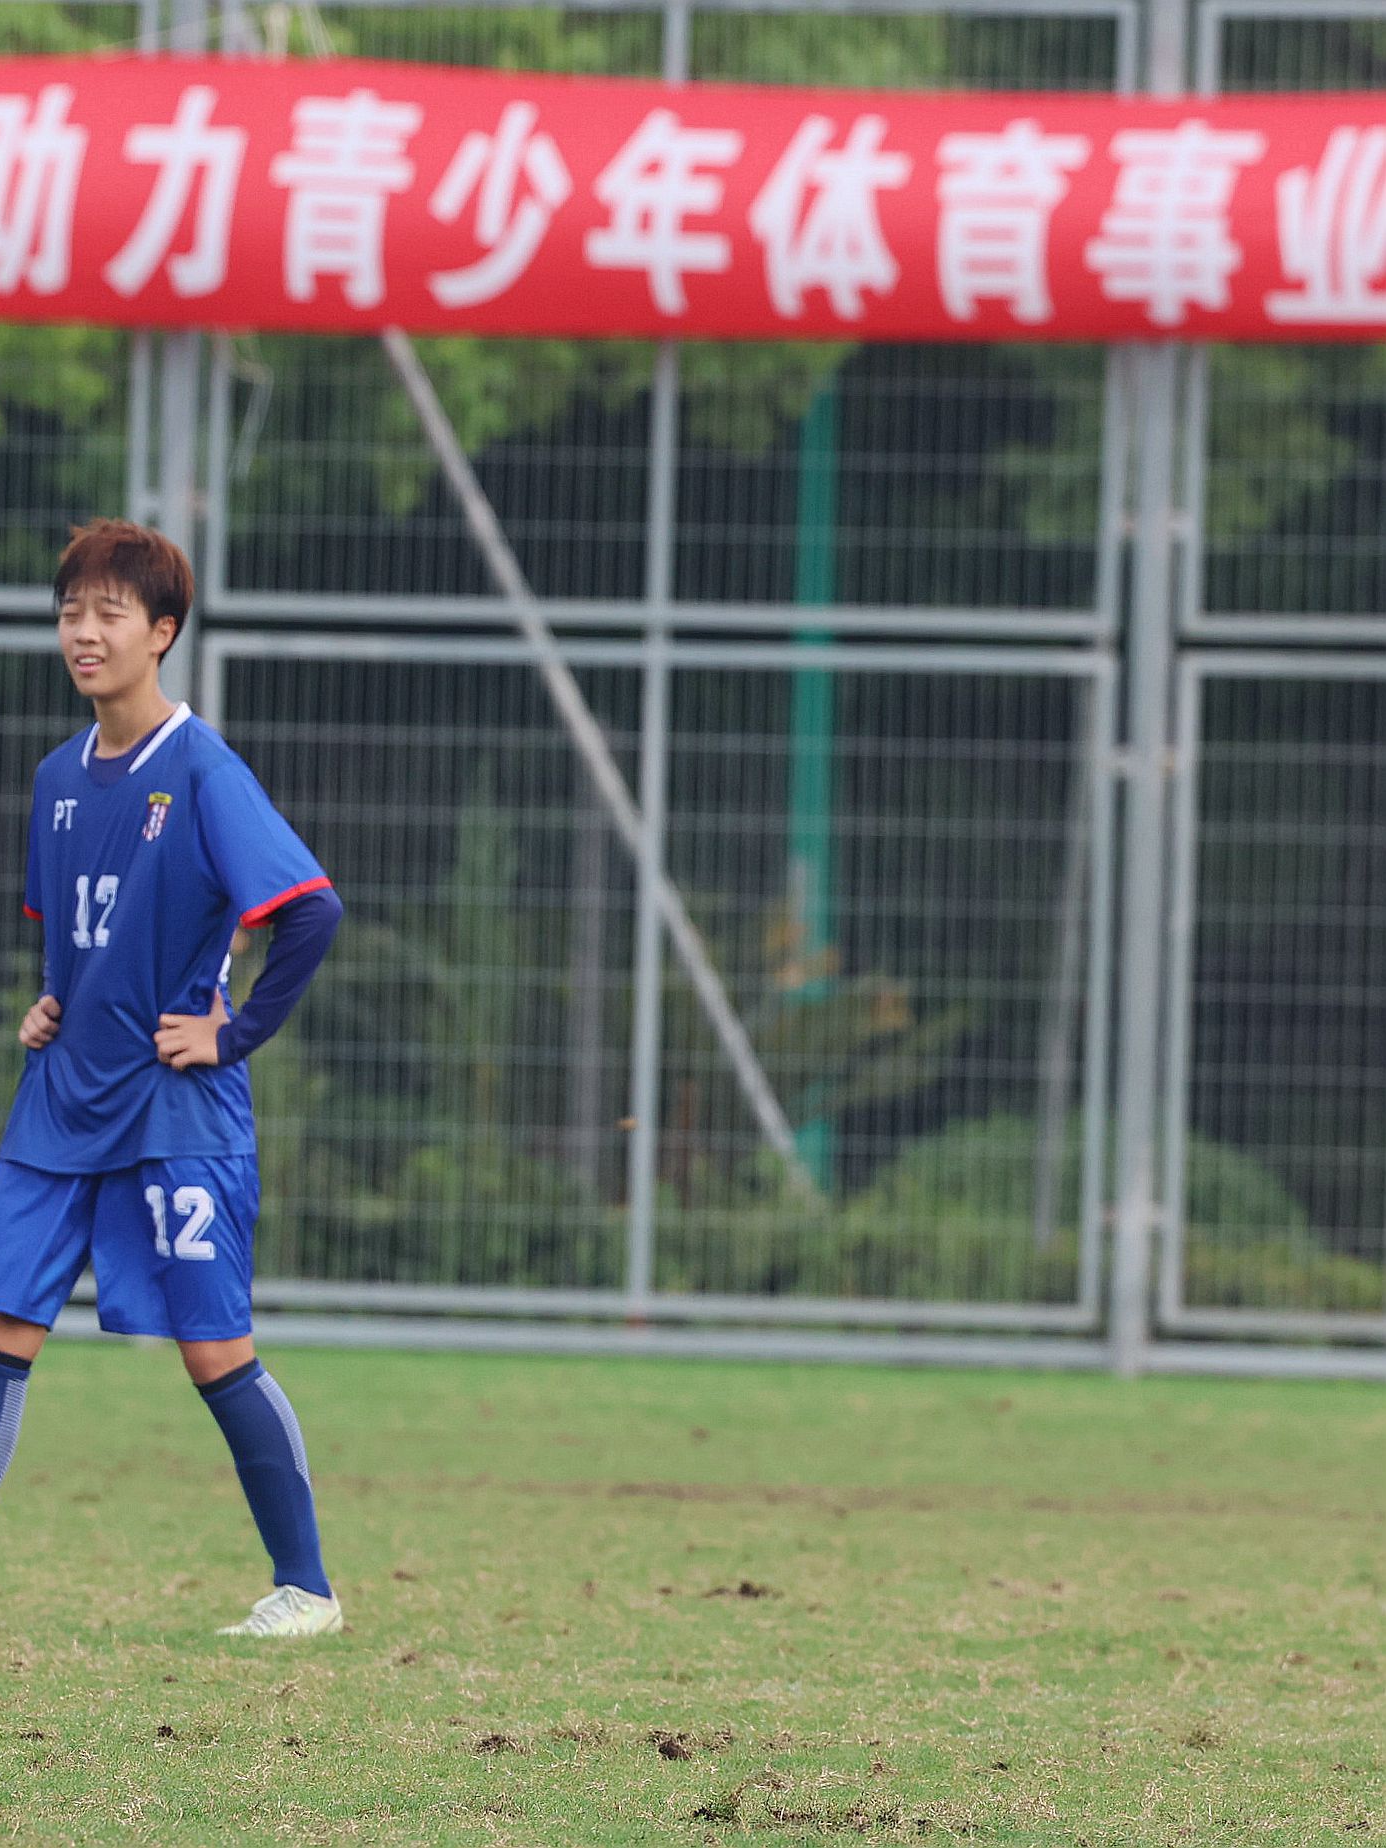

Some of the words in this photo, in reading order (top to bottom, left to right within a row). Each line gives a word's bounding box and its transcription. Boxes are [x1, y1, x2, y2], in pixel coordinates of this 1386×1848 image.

[53, 798, 78, 832] PT
[71, 874, 121, 949] 12
[144, 1184, 216, 1261] 12
